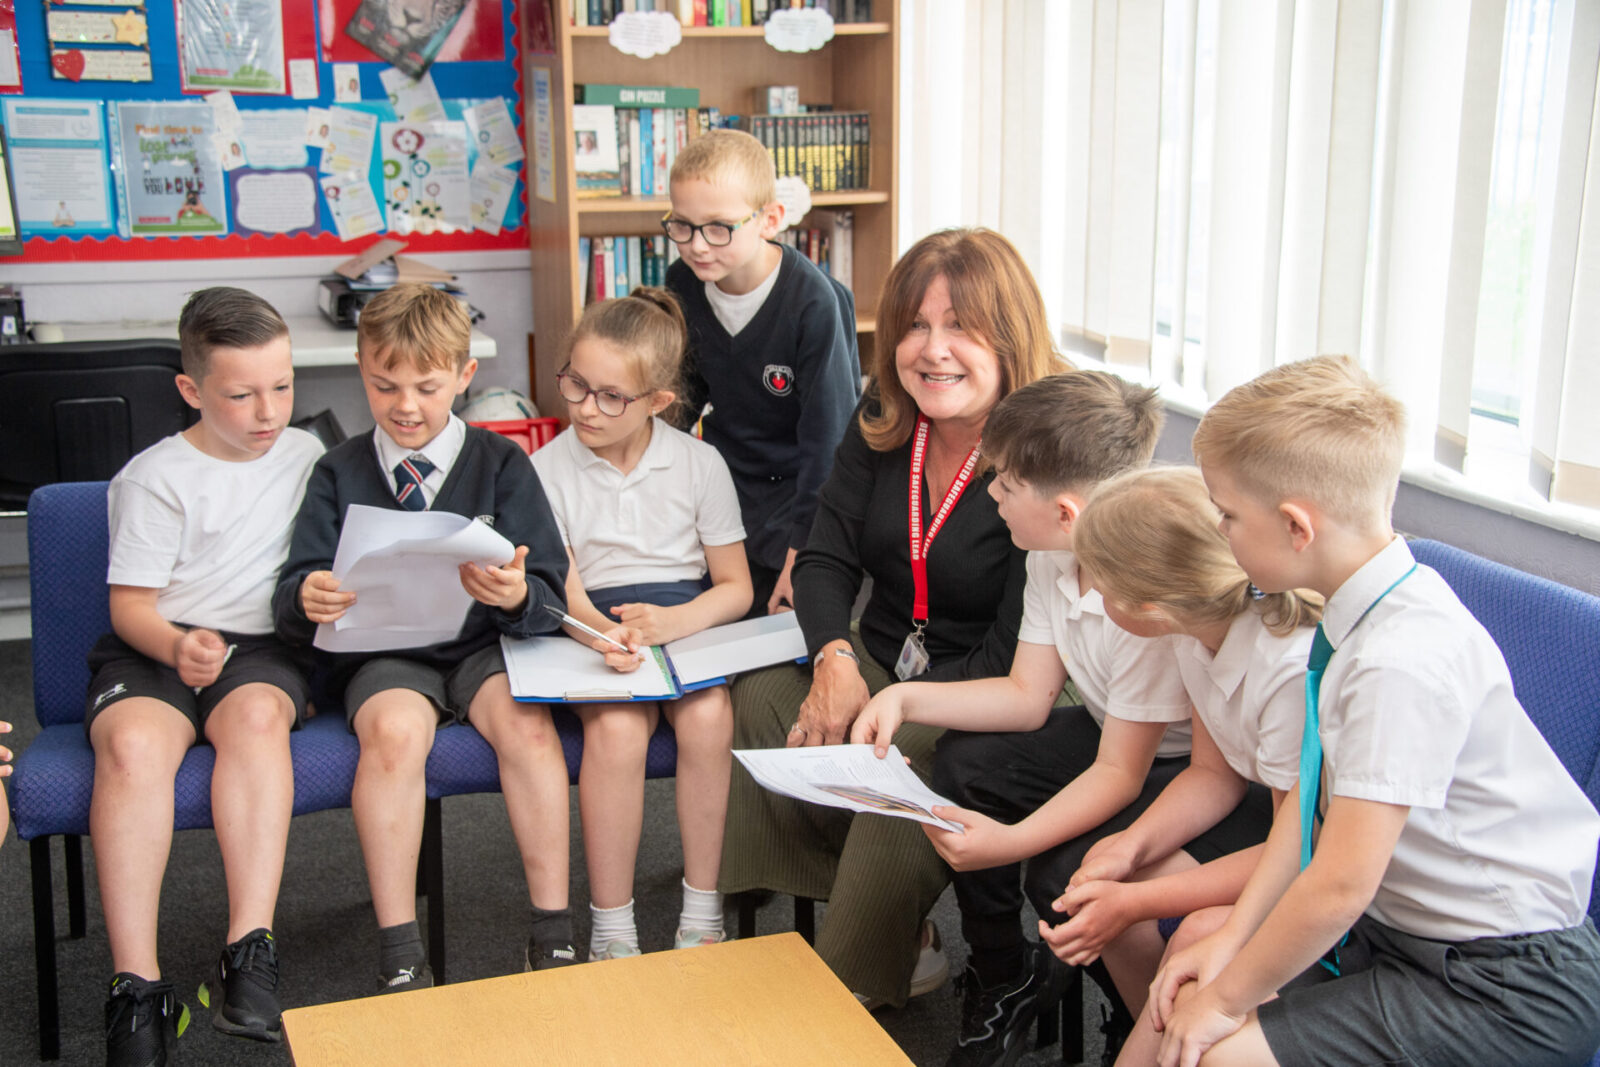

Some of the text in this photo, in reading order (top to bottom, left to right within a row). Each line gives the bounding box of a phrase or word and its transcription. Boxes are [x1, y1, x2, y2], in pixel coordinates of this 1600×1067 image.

[911, 422, 928, 560] DESIGNATED SAFEGUARDING LEAD
[959, 449, 980, 481] GNATED
[928, 479, 965, 538] SAFEGUARDING
